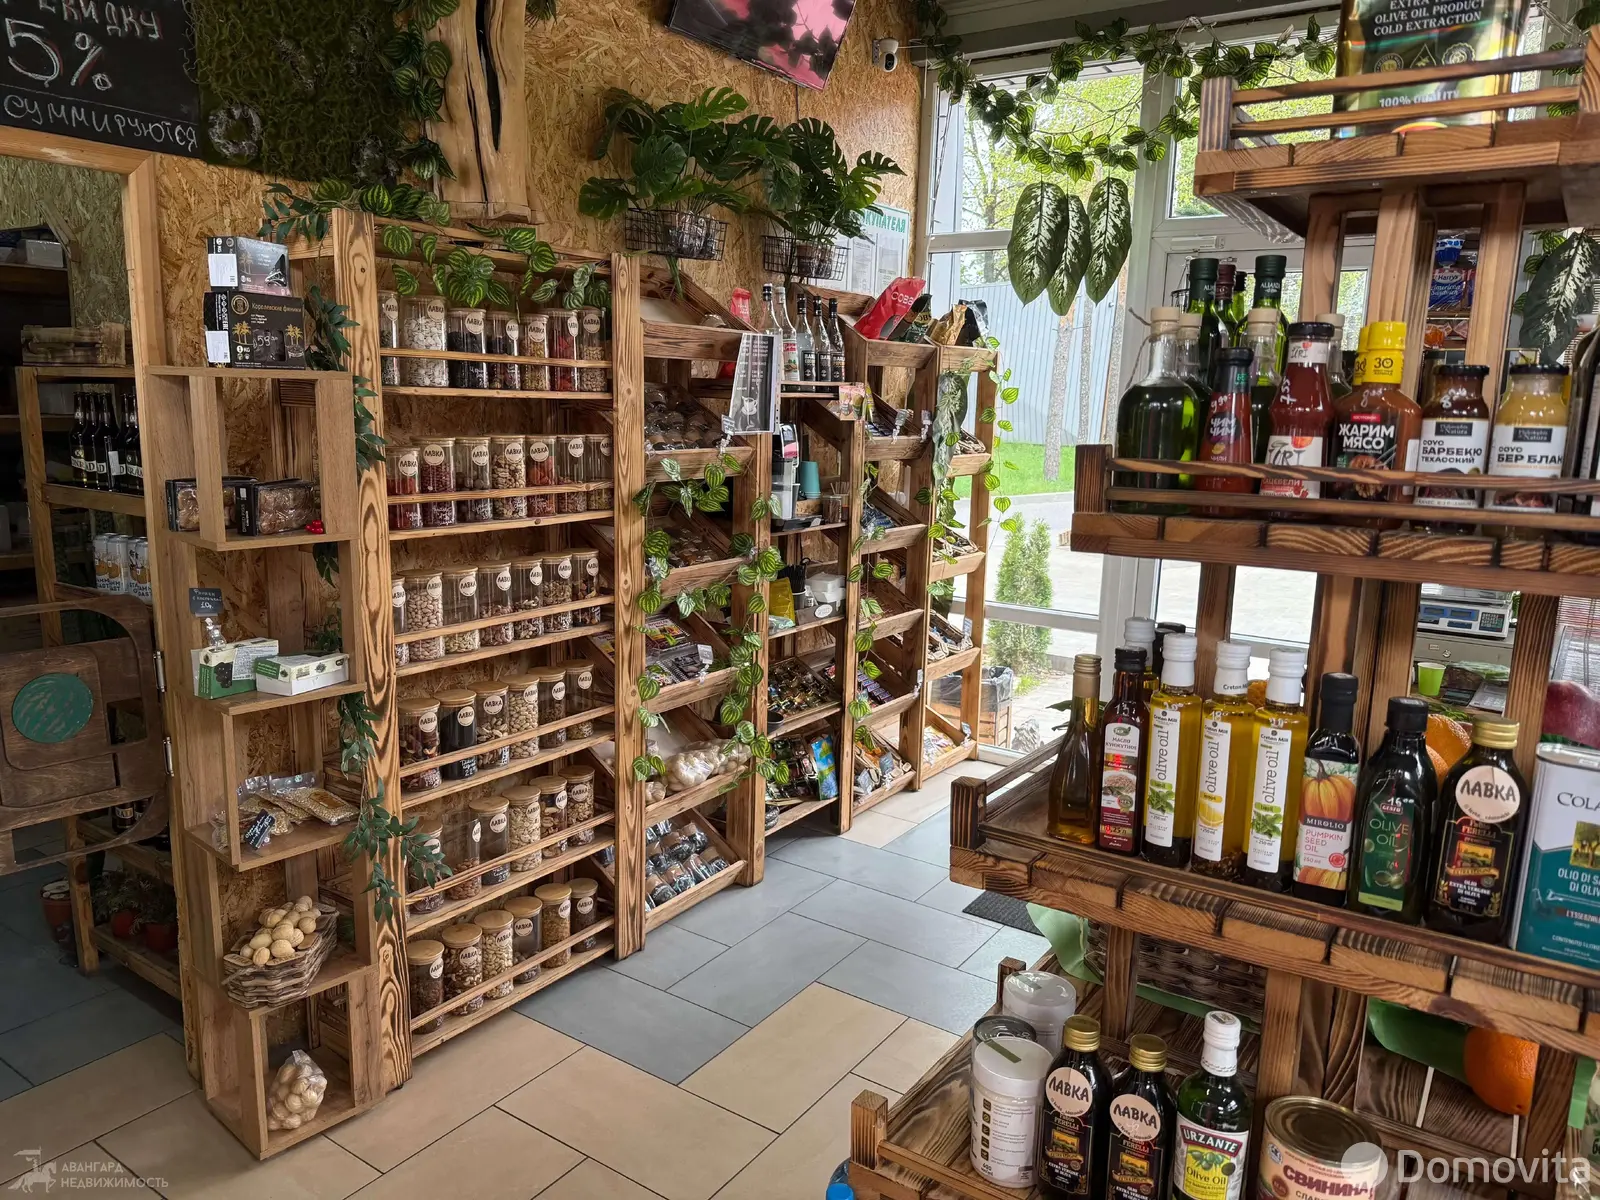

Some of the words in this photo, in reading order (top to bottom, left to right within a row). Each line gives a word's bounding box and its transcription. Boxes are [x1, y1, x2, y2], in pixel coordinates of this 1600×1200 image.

[1375, 10, 1408, 24] OLIVE
[1411, 8, 1429, 18] OIL
[1432, 0, 1485, 15] PRODUCT
[1373, 22, 1403, 36] COLD
[1405, 11, 1482, 31] EXTRACTION
[1379, 96, 1411, 108] 100%
[1210, 417, 1236, 427] ЧИМ
[1338, 423, 1395, 438] ЖАРИМ
[1210, 427, 1236, 436] ЧИМ
[530, 447, 548, 455] ЛАВКА
[1343, 436, 1384, 450] МЯСО
[1422, 447, 1483, 456] БАРБЕКЮ
[1421, 456, 1475, 464] ТЕХАССКИЙ
[1497, 454, 1525, 463] БЕР
[1158, 730, 1169, 747] oil
[1208, 741, 1219, 759] oil
[1156, 748, 1169, 781] olive
[1266, 750, 1279, 769] oil
[1205, 760, 1218, 793] olive
[1262, 769, 1277, 804] olive
[1460, 779, 1516, 802] ЛАВКА
[1305, 829, 1343, 841] PUMPKIN
[1369, 818, 1410, 836] OLIVE
[1304, 844, 1319, 853] OIL
[1305, 836, 1327, 846] SEED
[1376, 834, 1398, 848] OIL
[1558, 868, 1579, 881] OLIO
[1580, 872, 1591, 883] DI
[1592, 875, 1600, 885] S
[1569, 881, 1579, 892] DI
[461, 951, 477, 959] ЛАВКА
[1049, 1077, 1089, 1102] ЛАВКА
[1113, 1104, 1157, 1129] ЛАВКА
[1183, 1129, 1238, 1153] URZANTE
[1187, 1166, 1210, 1183] Olive
[1212, 1176, 1226, 1185] Oil
[1283, 1165, 1368, 1196] СВИНИНА
